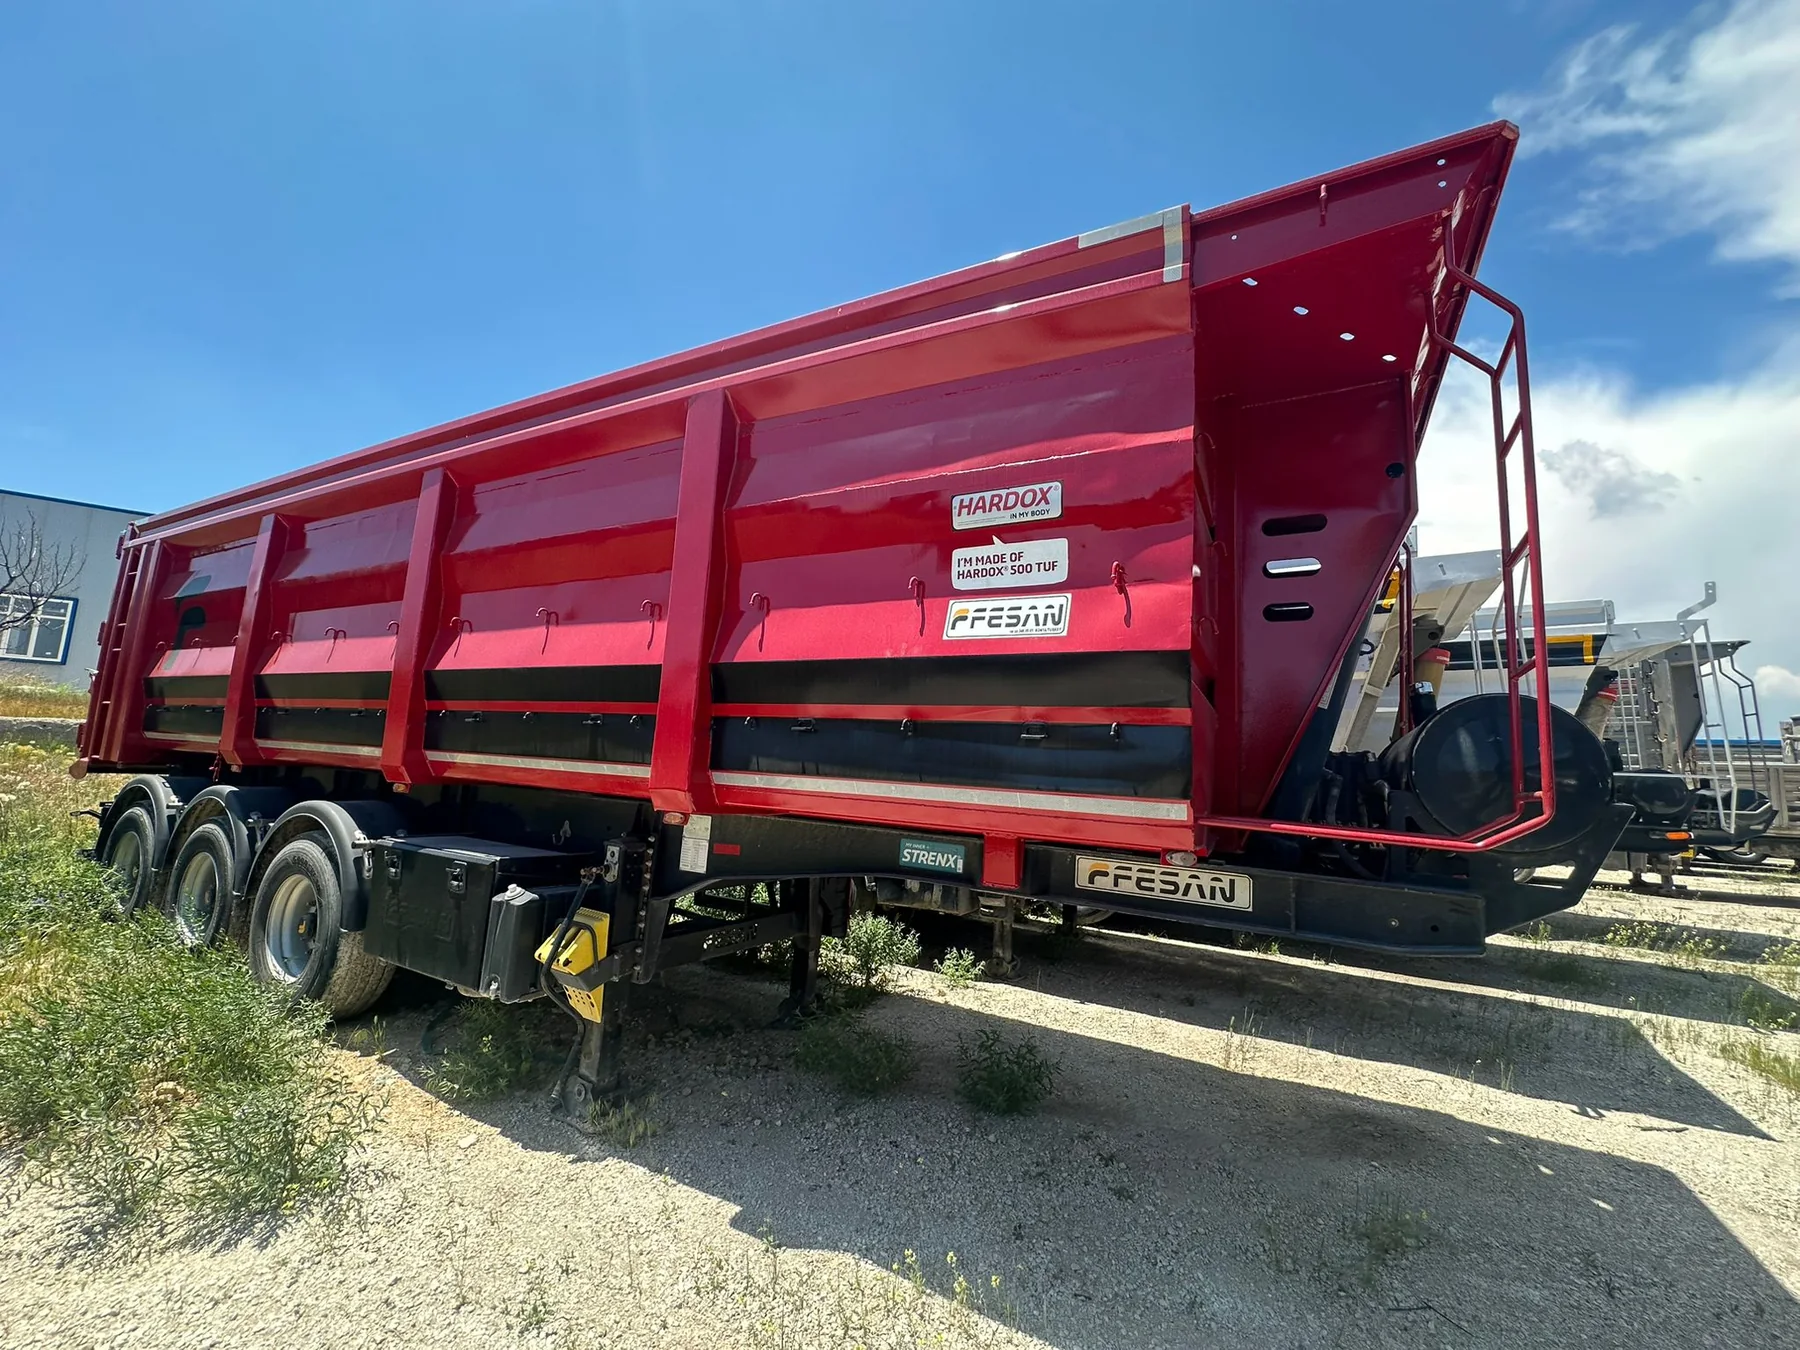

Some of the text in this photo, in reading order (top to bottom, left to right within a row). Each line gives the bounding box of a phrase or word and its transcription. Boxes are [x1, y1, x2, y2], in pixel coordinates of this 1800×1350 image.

[957, 485, 1053, 517] HARDOX
[1018, 510, 1030, 518] MY
[1031, 508, 1051, 517] BODY
[957, 551, 1024, 568] I'M MADE OF
[1009, 563, 1033, 575] 500
[1035, 560, 1059, 573] TUF
[901, 848, 958, 868] STRENX
